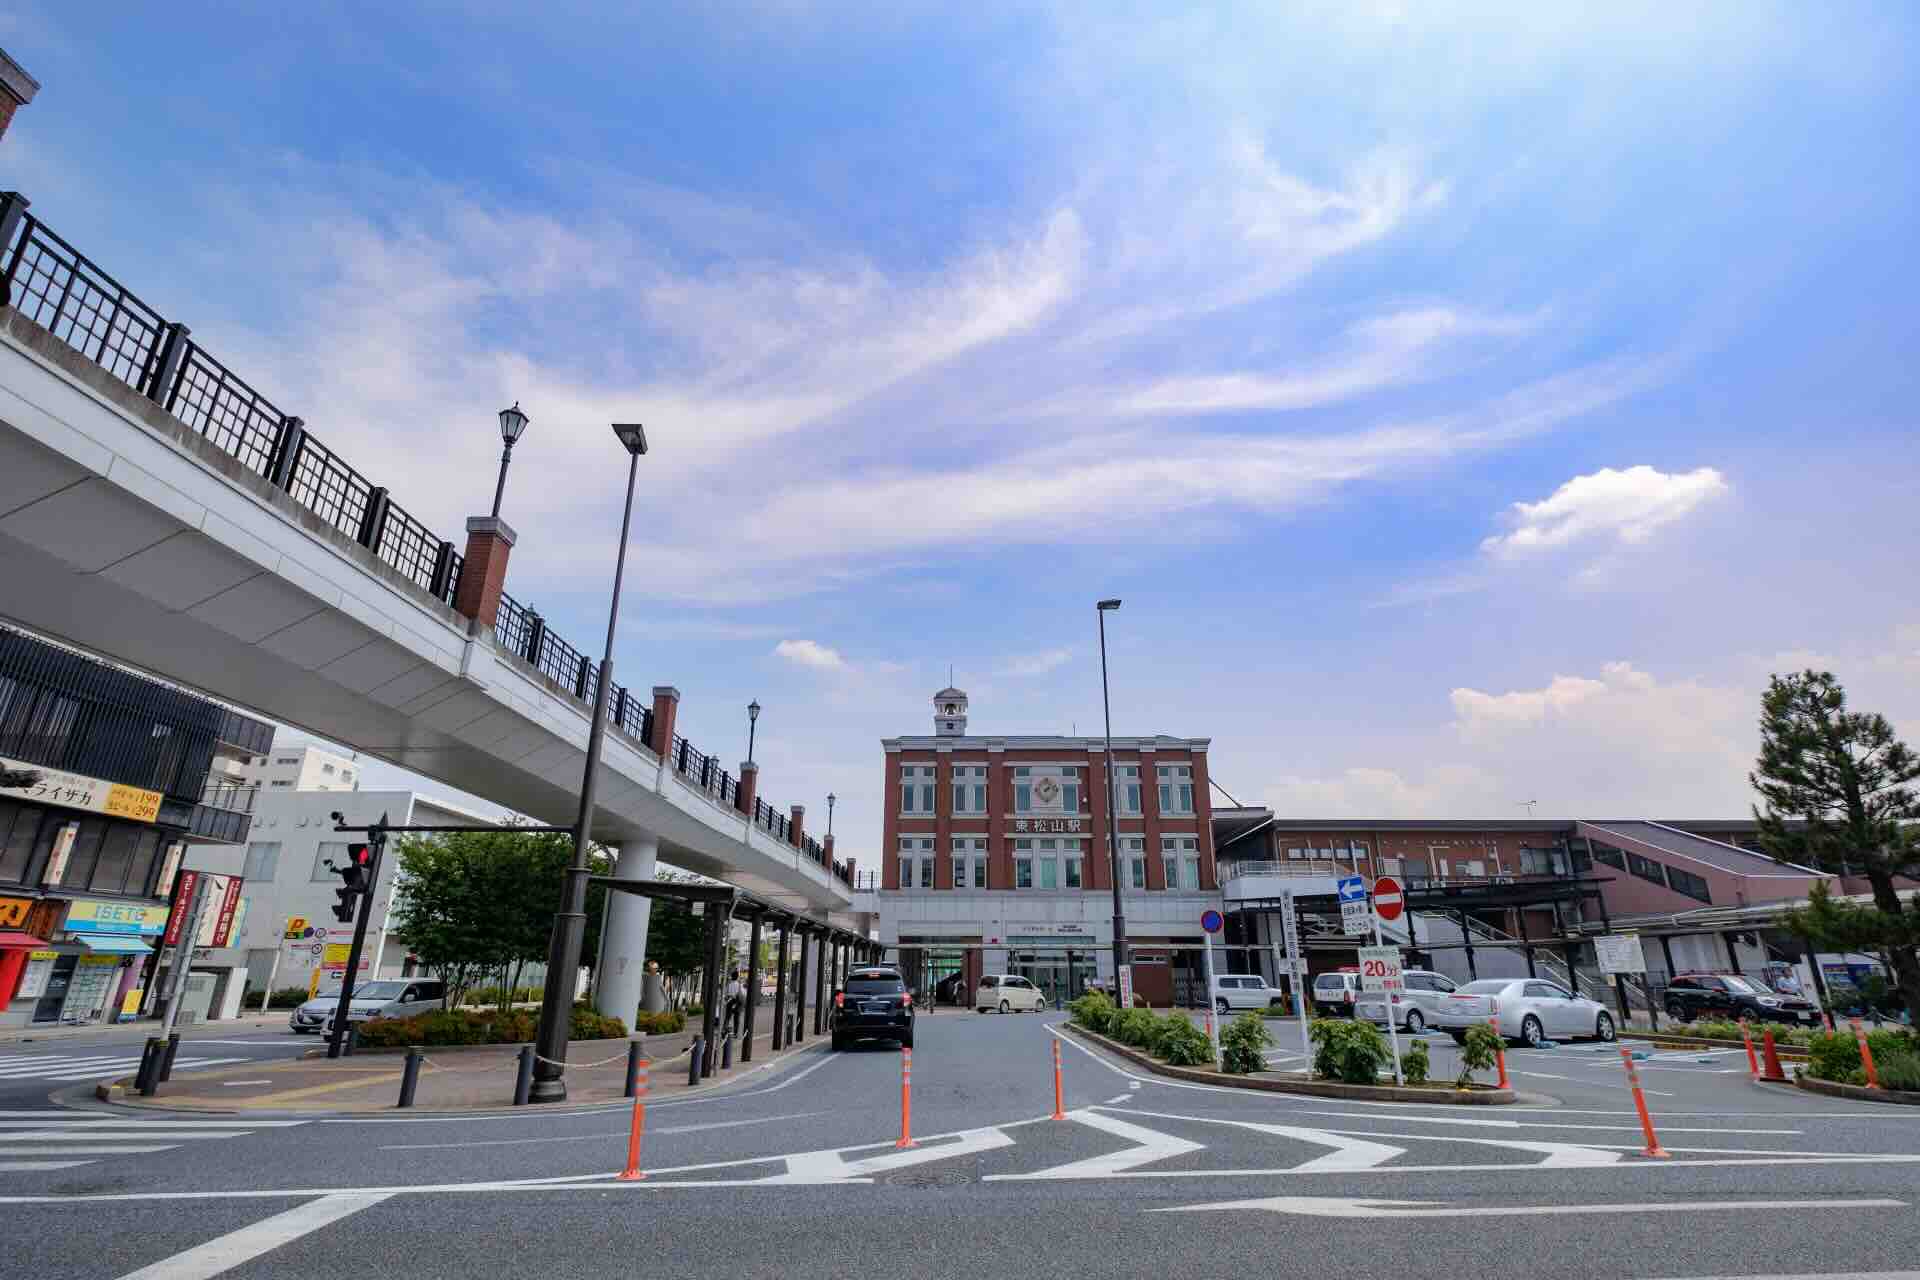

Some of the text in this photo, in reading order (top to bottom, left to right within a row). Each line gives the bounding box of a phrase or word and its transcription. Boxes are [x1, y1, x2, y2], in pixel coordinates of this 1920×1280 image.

[22, 783, 94, 806] ライザカ
[1015, 819, 1081, 833] 東松山駅
